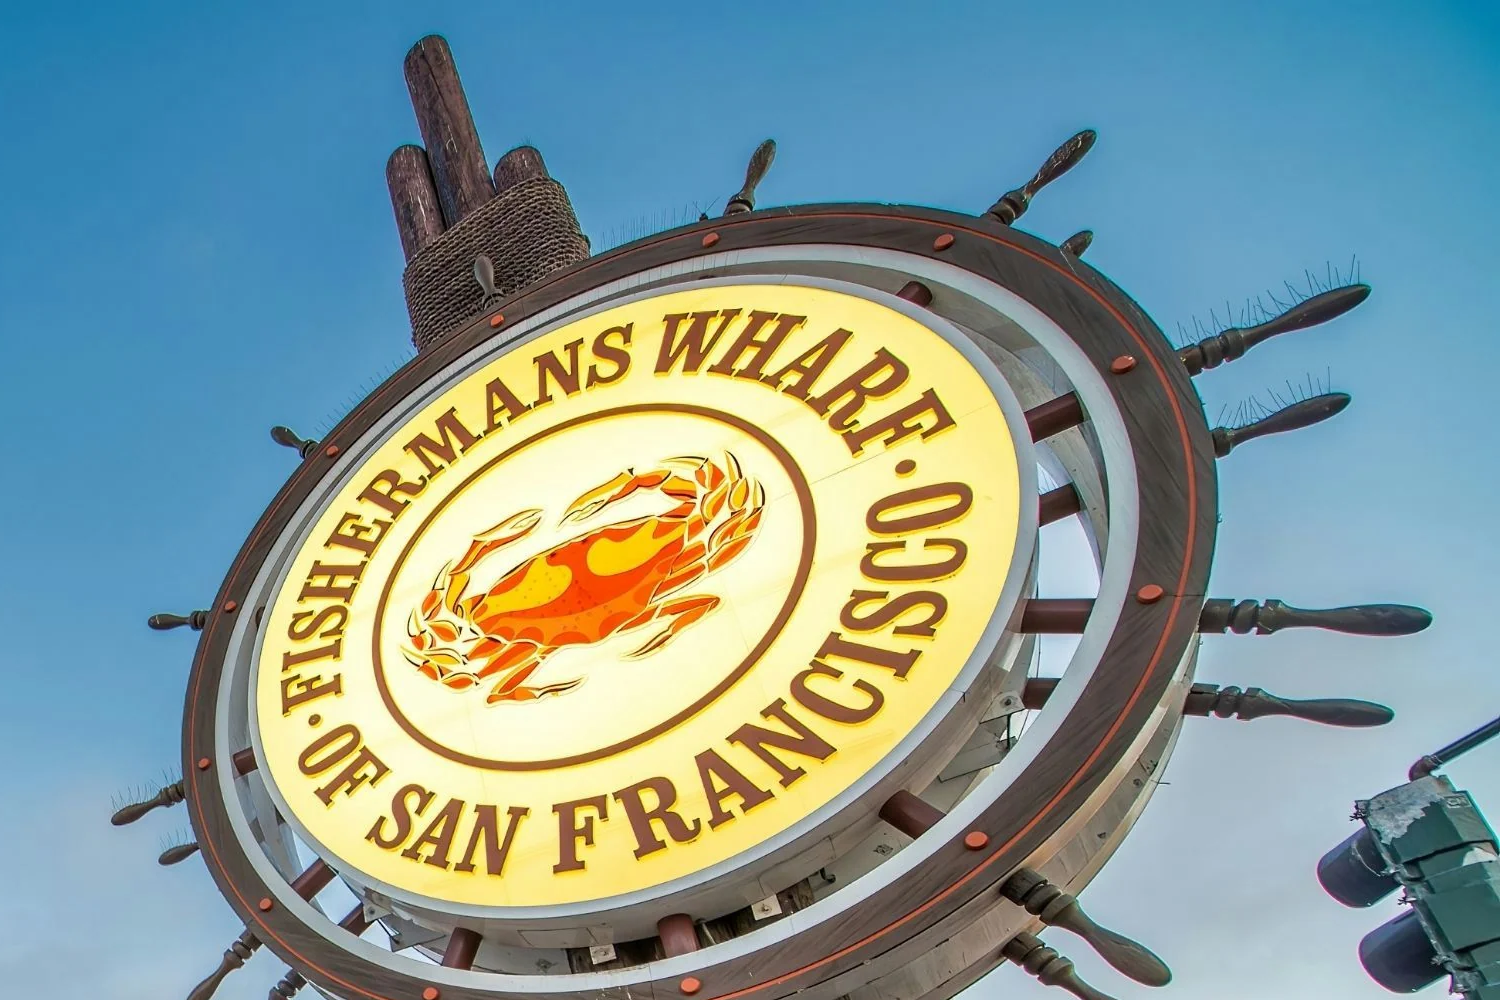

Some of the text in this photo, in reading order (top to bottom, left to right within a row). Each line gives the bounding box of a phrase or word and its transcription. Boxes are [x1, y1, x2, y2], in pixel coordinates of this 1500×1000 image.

[281, 308, 956, 718] FISHERMANS WHARF
[297, 480, 974, 877] OF SAN FRANCISCO
